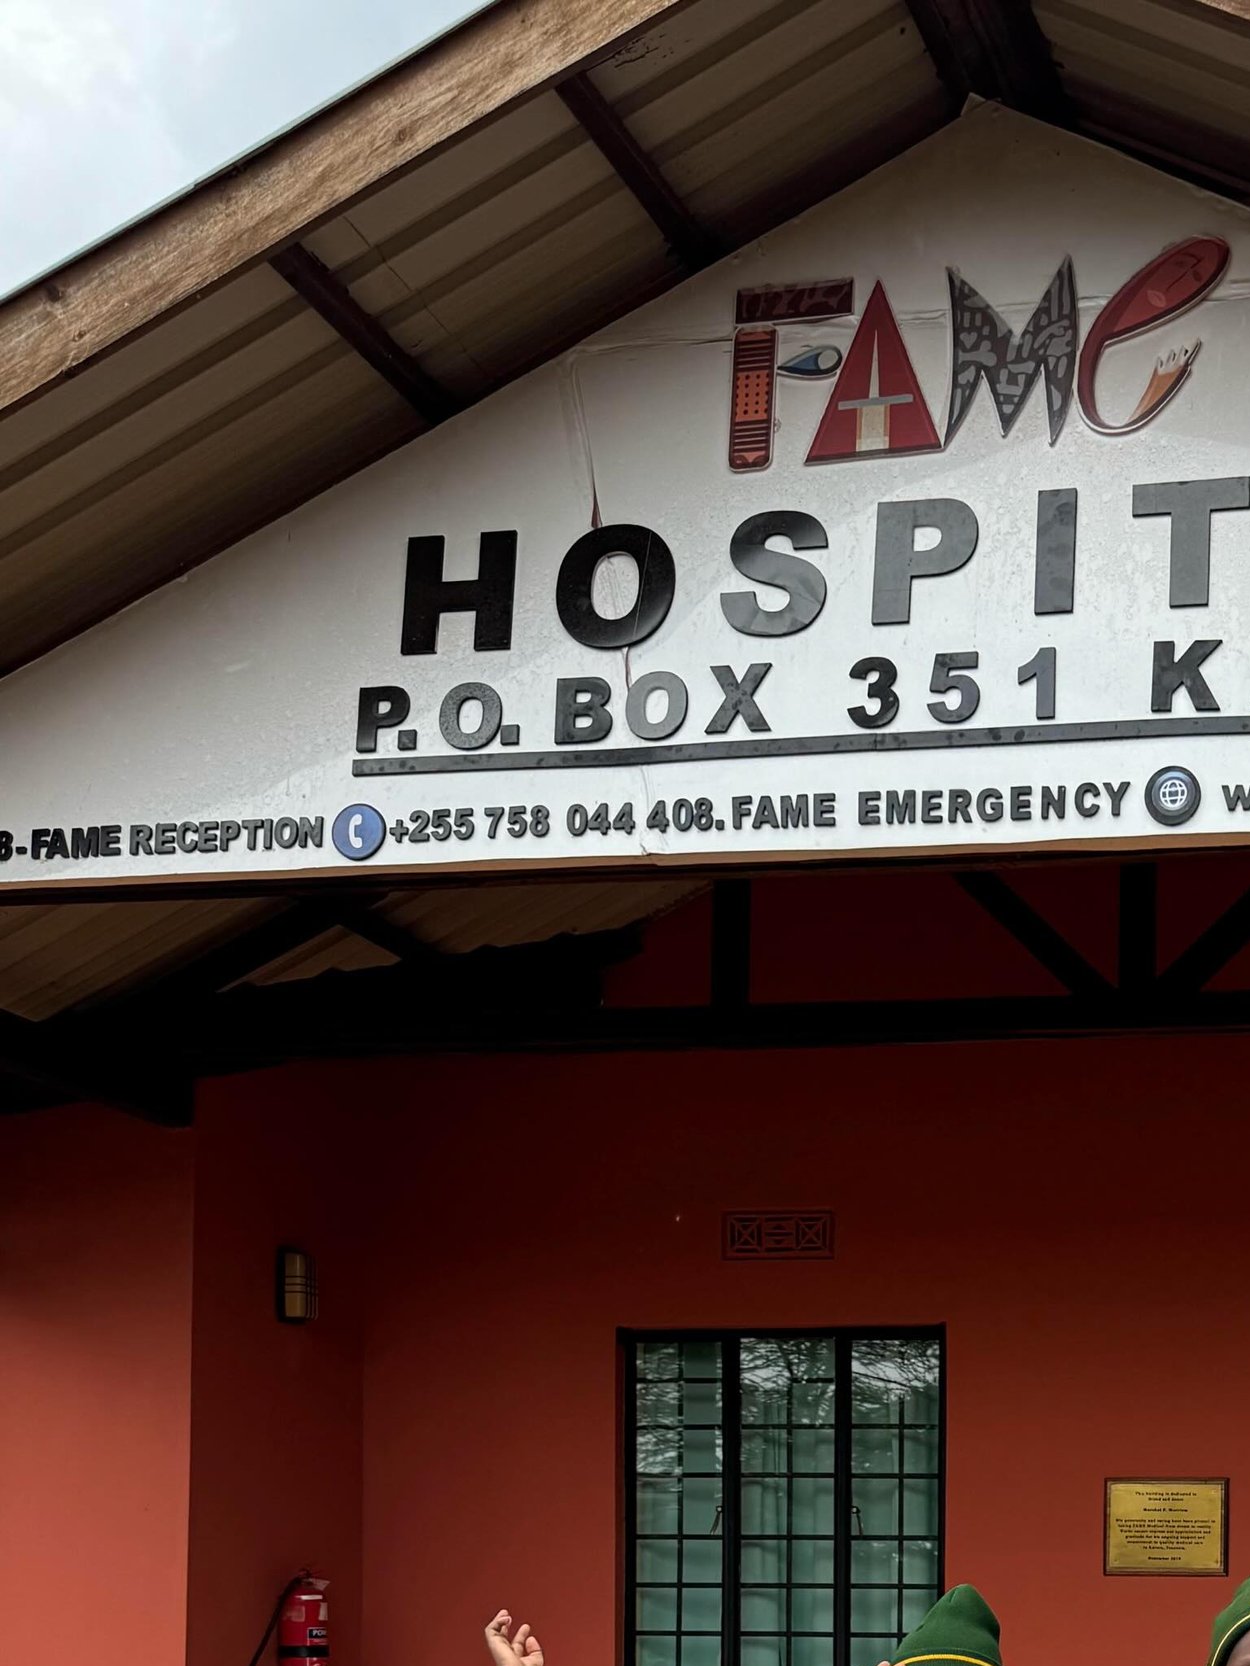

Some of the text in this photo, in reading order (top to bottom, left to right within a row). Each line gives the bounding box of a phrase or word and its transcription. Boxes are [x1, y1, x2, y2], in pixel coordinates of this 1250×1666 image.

[728, 234, 1232, 472] FAME
[356, 682, 520, 753] P.O.
[554, 662, 773, 745] BOX
[846, 647, 1057, 728] 351
[129, 816, 324, 856] RECEPTION
[389, 807, 475, 843] +255
[484, 805, 550, 838] 758
[566, 802, 635, 836] 044
[858, 781, 1130, 825] EMERGENCY
